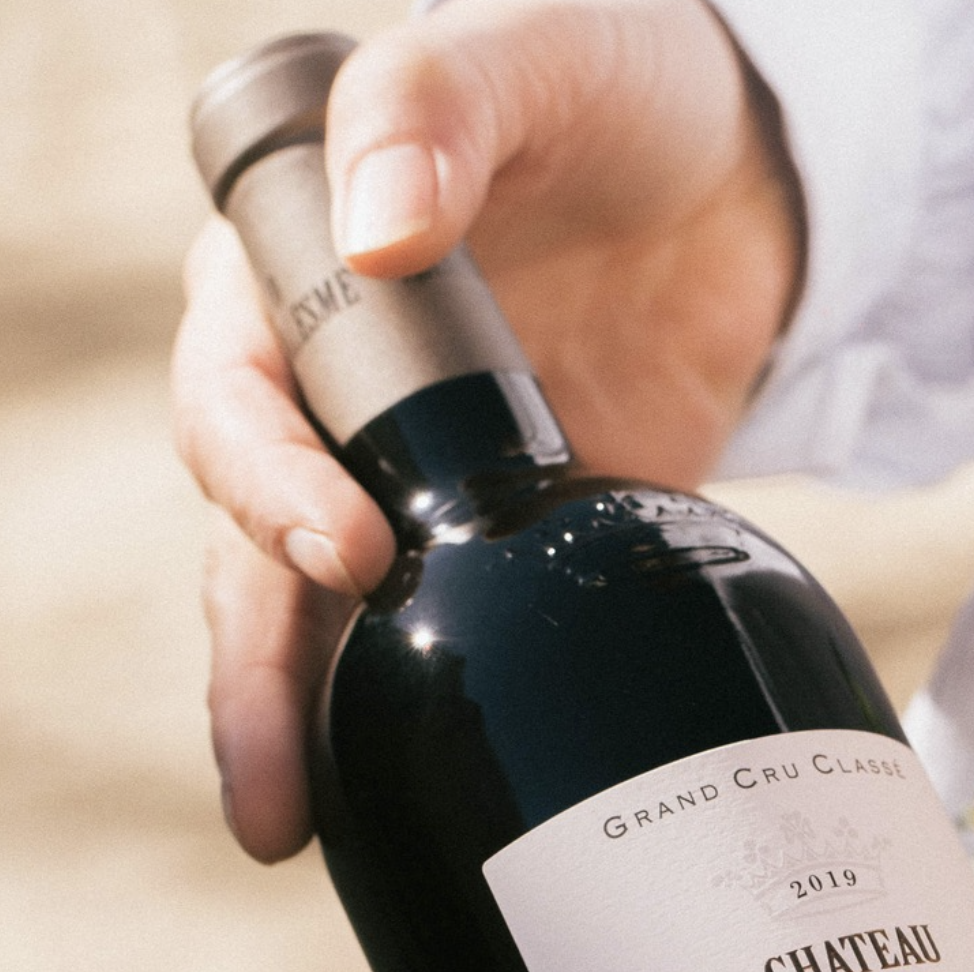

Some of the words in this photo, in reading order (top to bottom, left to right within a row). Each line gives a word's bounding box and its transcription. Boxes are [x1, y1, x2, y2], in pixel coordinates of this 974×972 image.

[603, 784, 719, 838] GRAND
[733, 763, 800, 789] CRU
[790, 869, 857, 898] 2019
